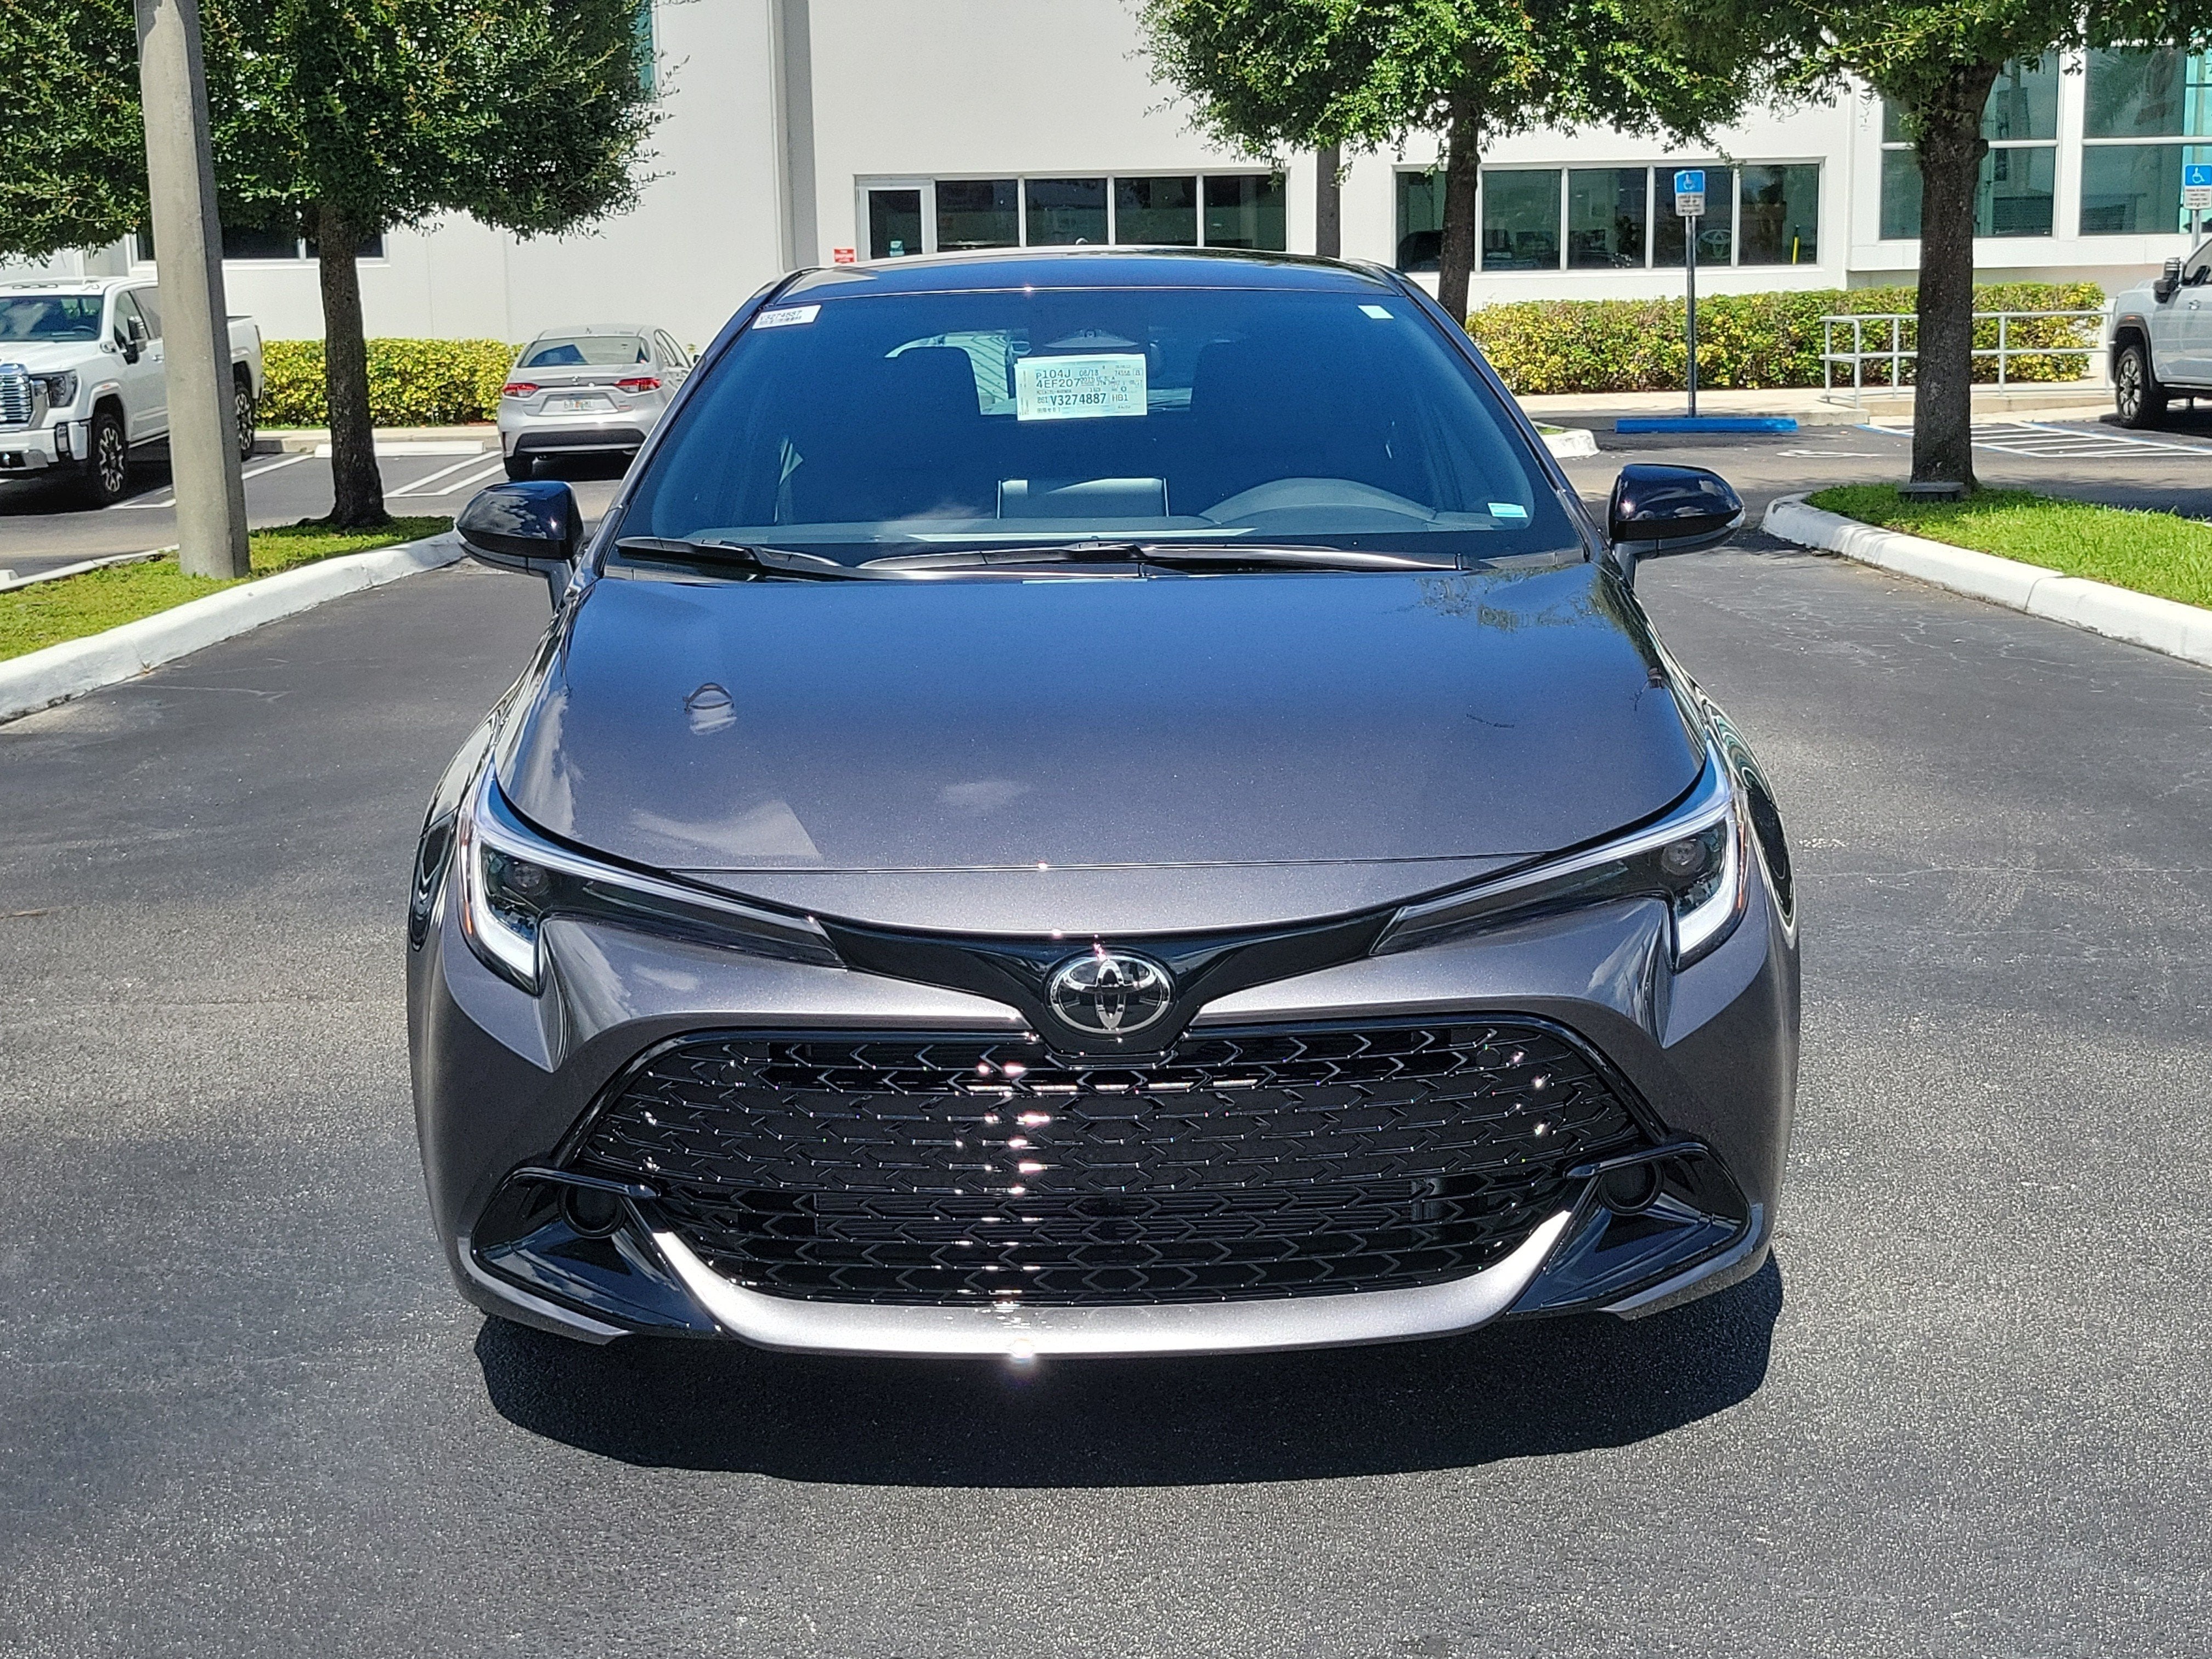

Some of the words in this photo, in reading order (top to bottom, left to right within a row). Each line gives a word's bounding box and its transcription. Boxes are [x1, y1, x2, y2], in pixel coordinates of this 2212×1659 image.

[1036, 369, 1071, 380] P104J
[1036, 378, 1080, 388] 4EF207
[1050, 393, 1107, 406] V3274887
[1111, 394, 1129, 402] HB1
